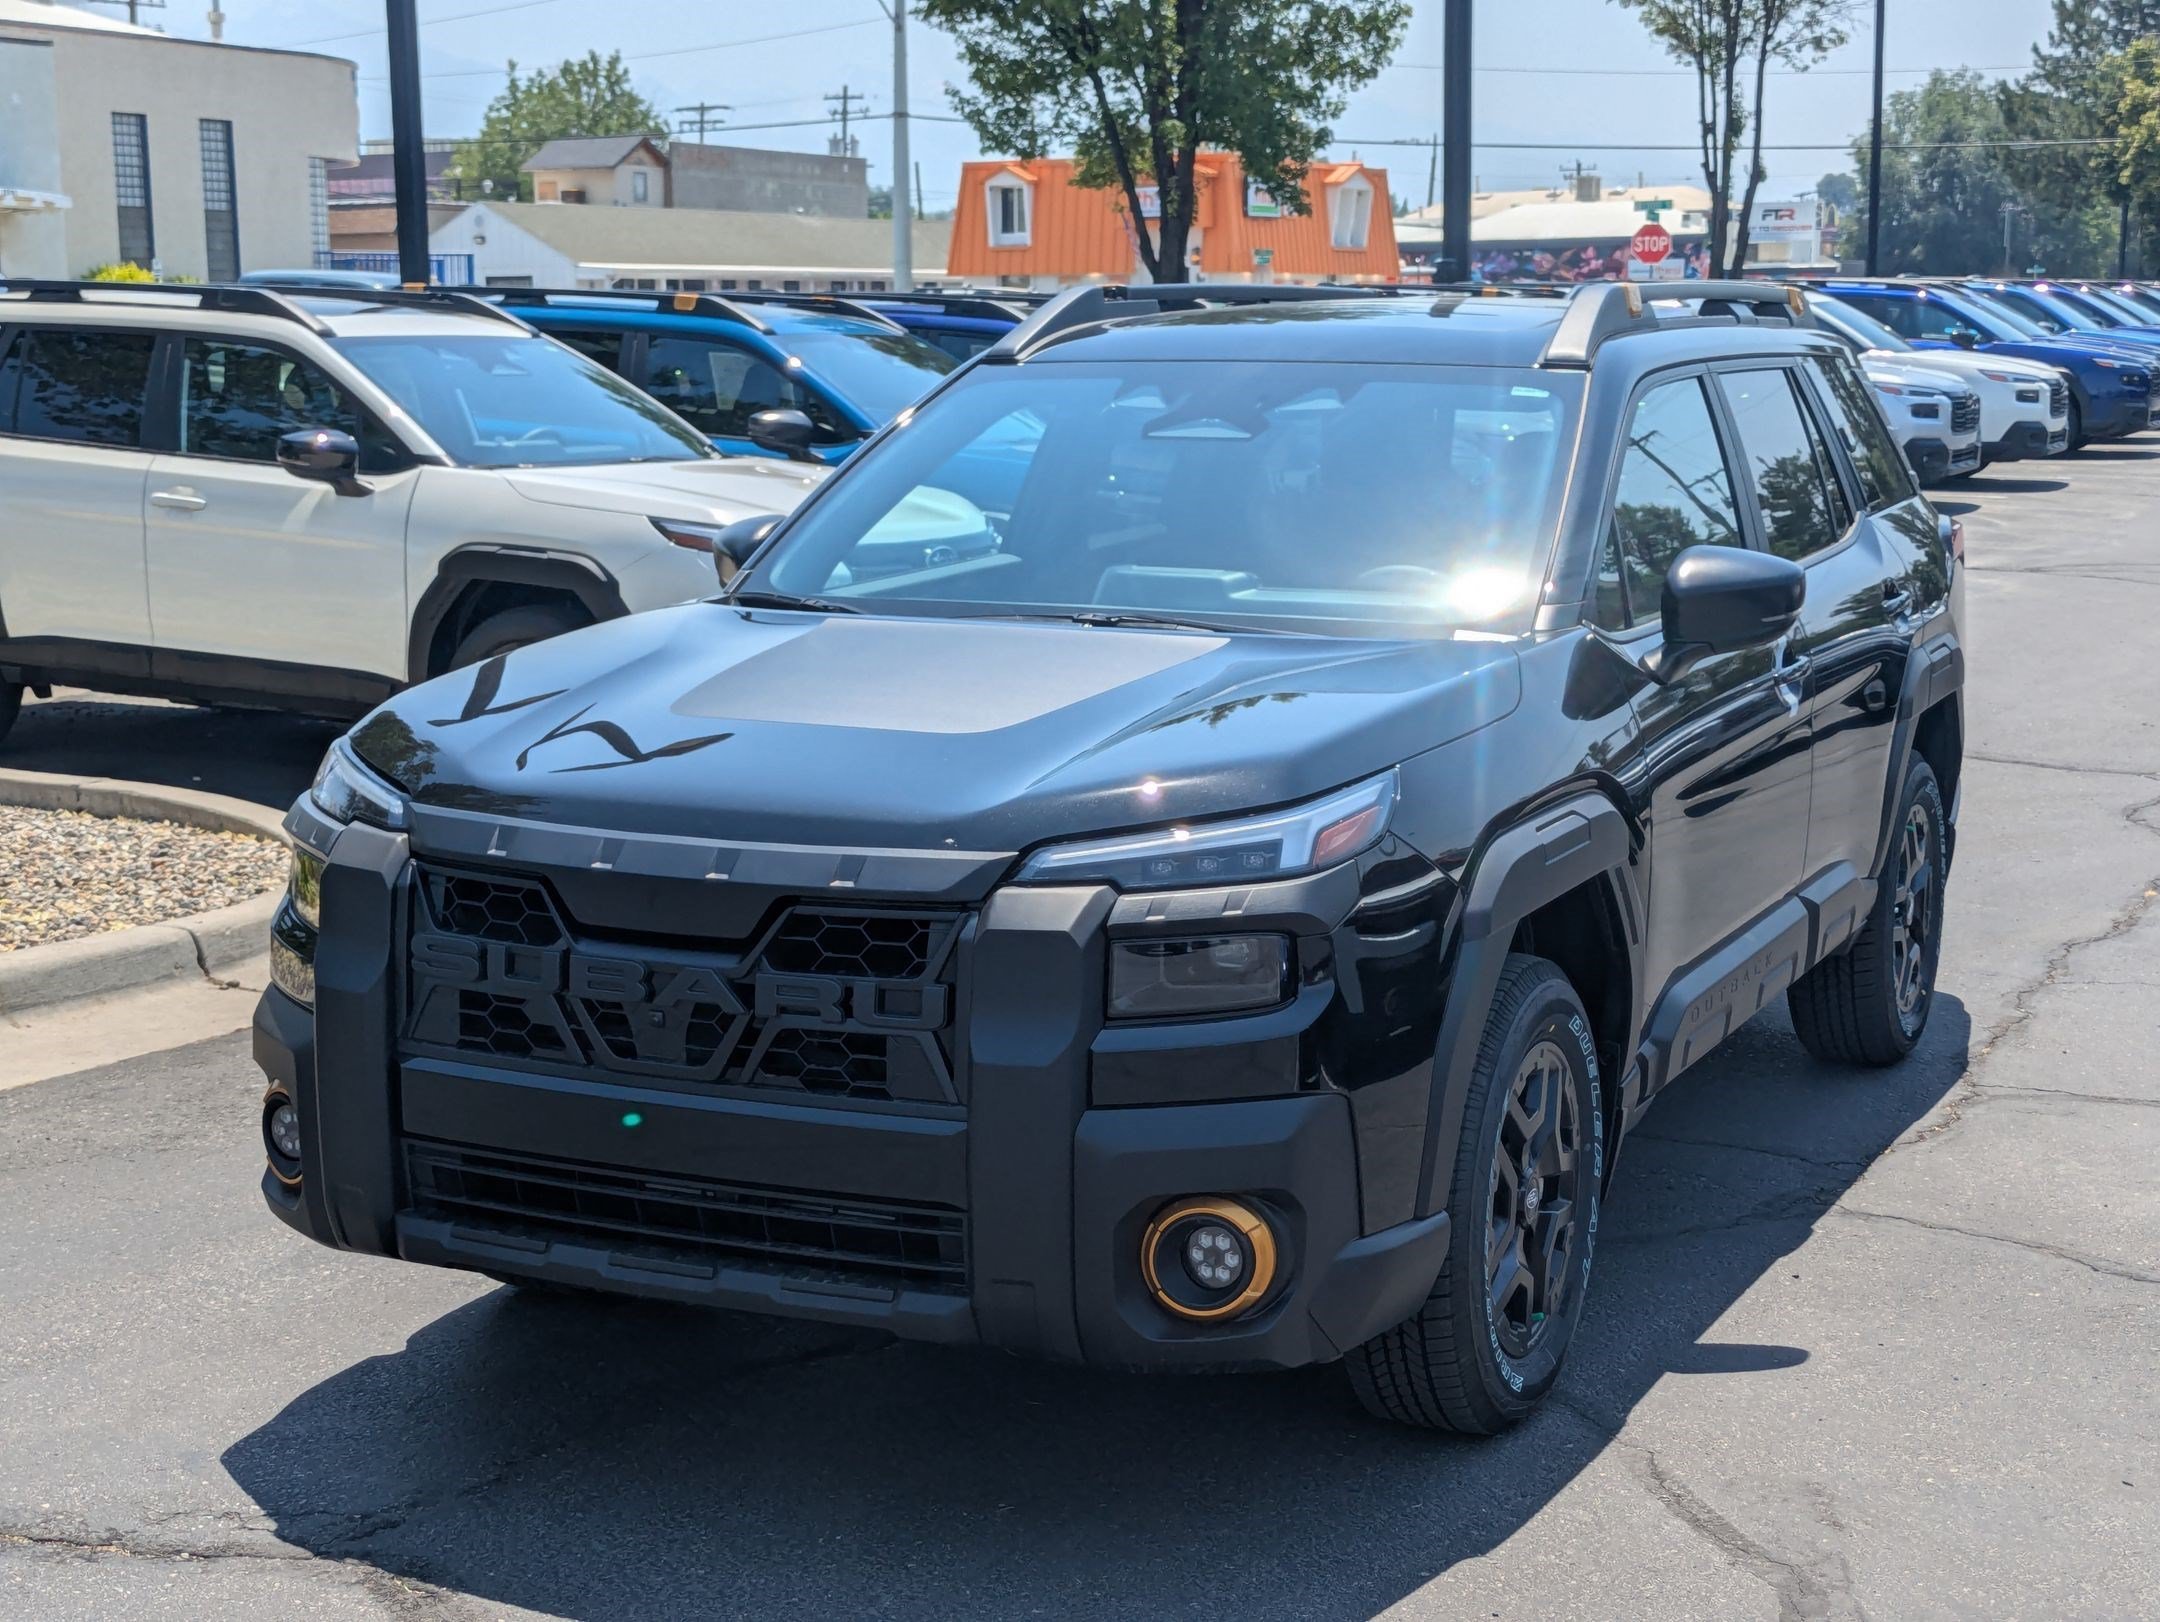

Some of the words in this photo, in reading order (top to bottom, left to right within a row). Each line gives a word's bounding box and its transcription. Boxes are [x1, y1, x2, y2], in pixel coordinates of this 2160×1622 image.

[1633, 236, 1668, 253] STOP
[411, 933, 949, 1031] SUBARU
[1690, 952, 1772, 1023] OUTBACK
[1569, 1015, 1603, 1178] DUELER
